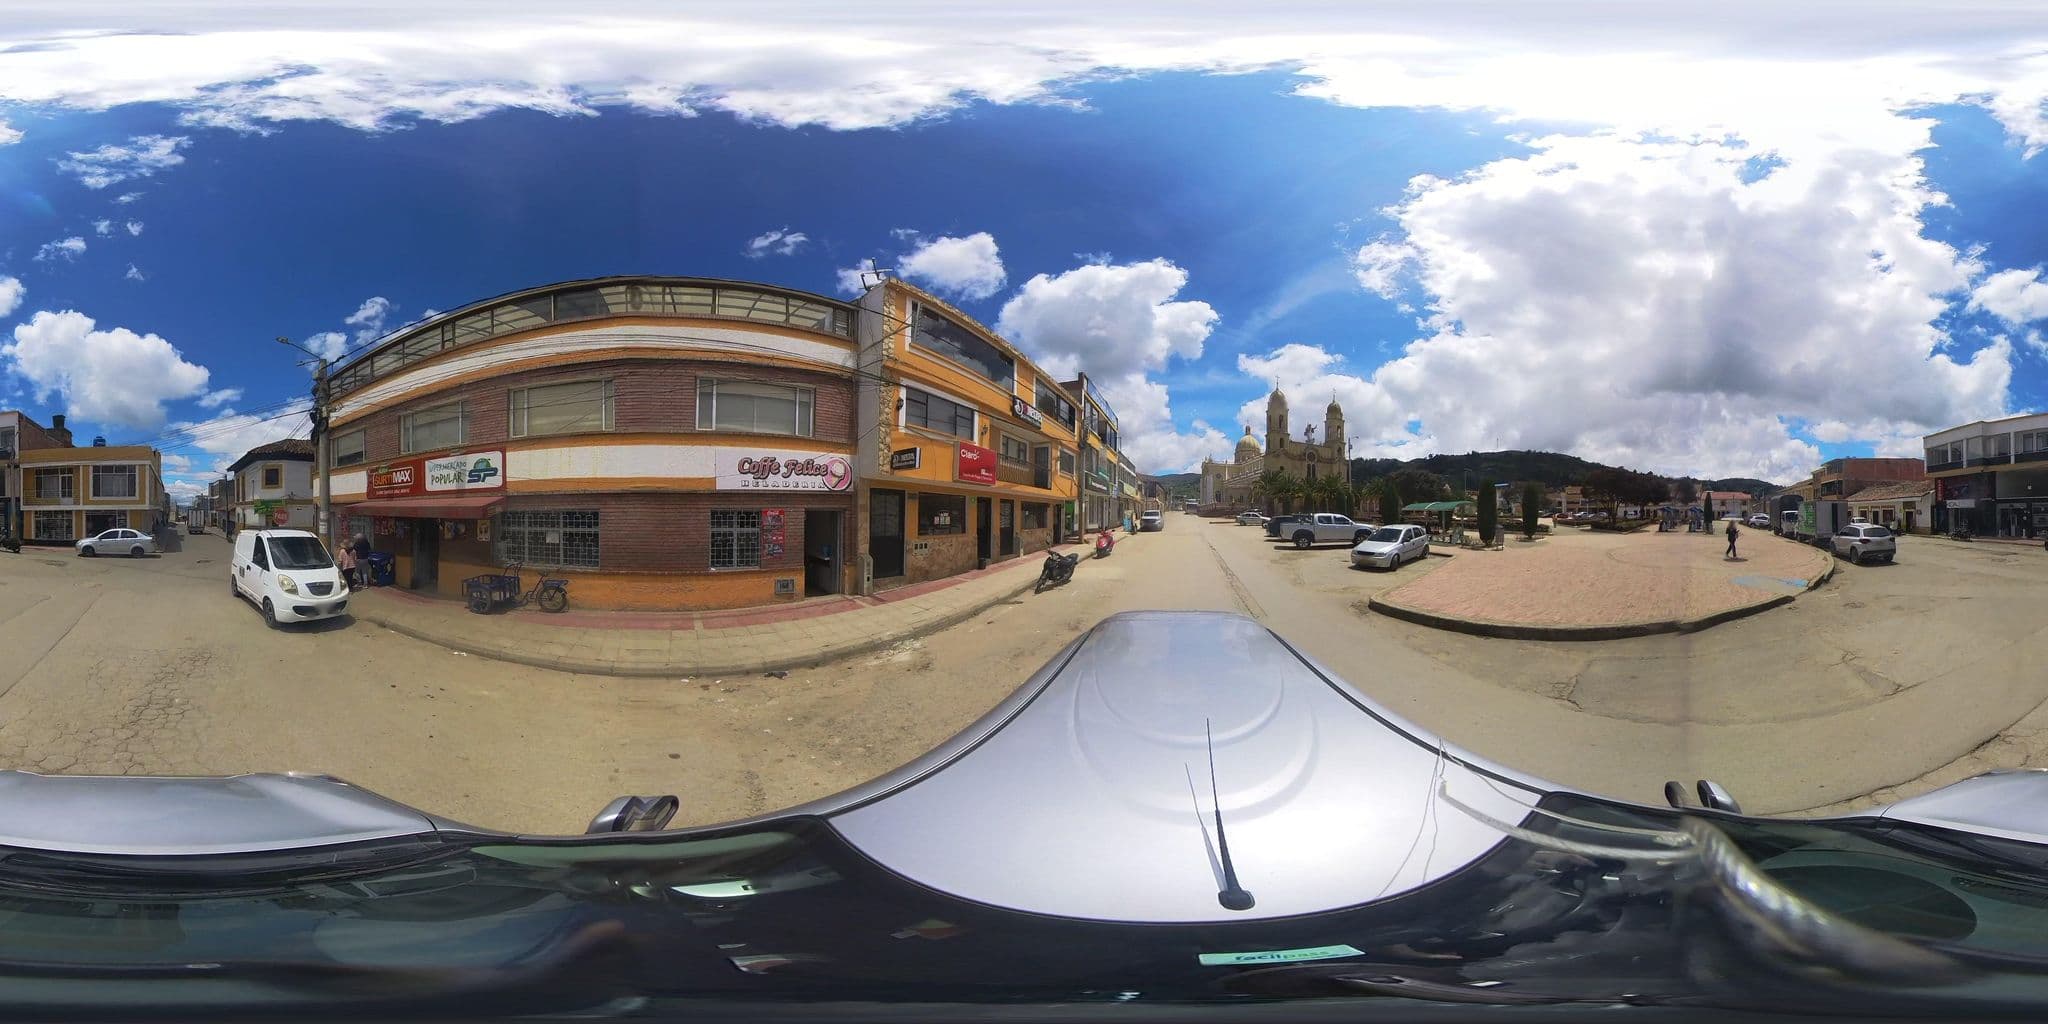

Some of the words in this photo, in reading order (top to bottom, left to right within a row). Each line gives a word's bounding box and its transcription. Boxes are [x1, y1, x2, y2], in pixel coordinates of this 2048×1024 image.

[961, 449, 978, 460] Claro
[738, 457, 781, 479] Coffe
[782, 459, 829, 478] Felice
[431, 471, 464, 486] POPULAR
[740, 480, 826, 489] HELADERIA
